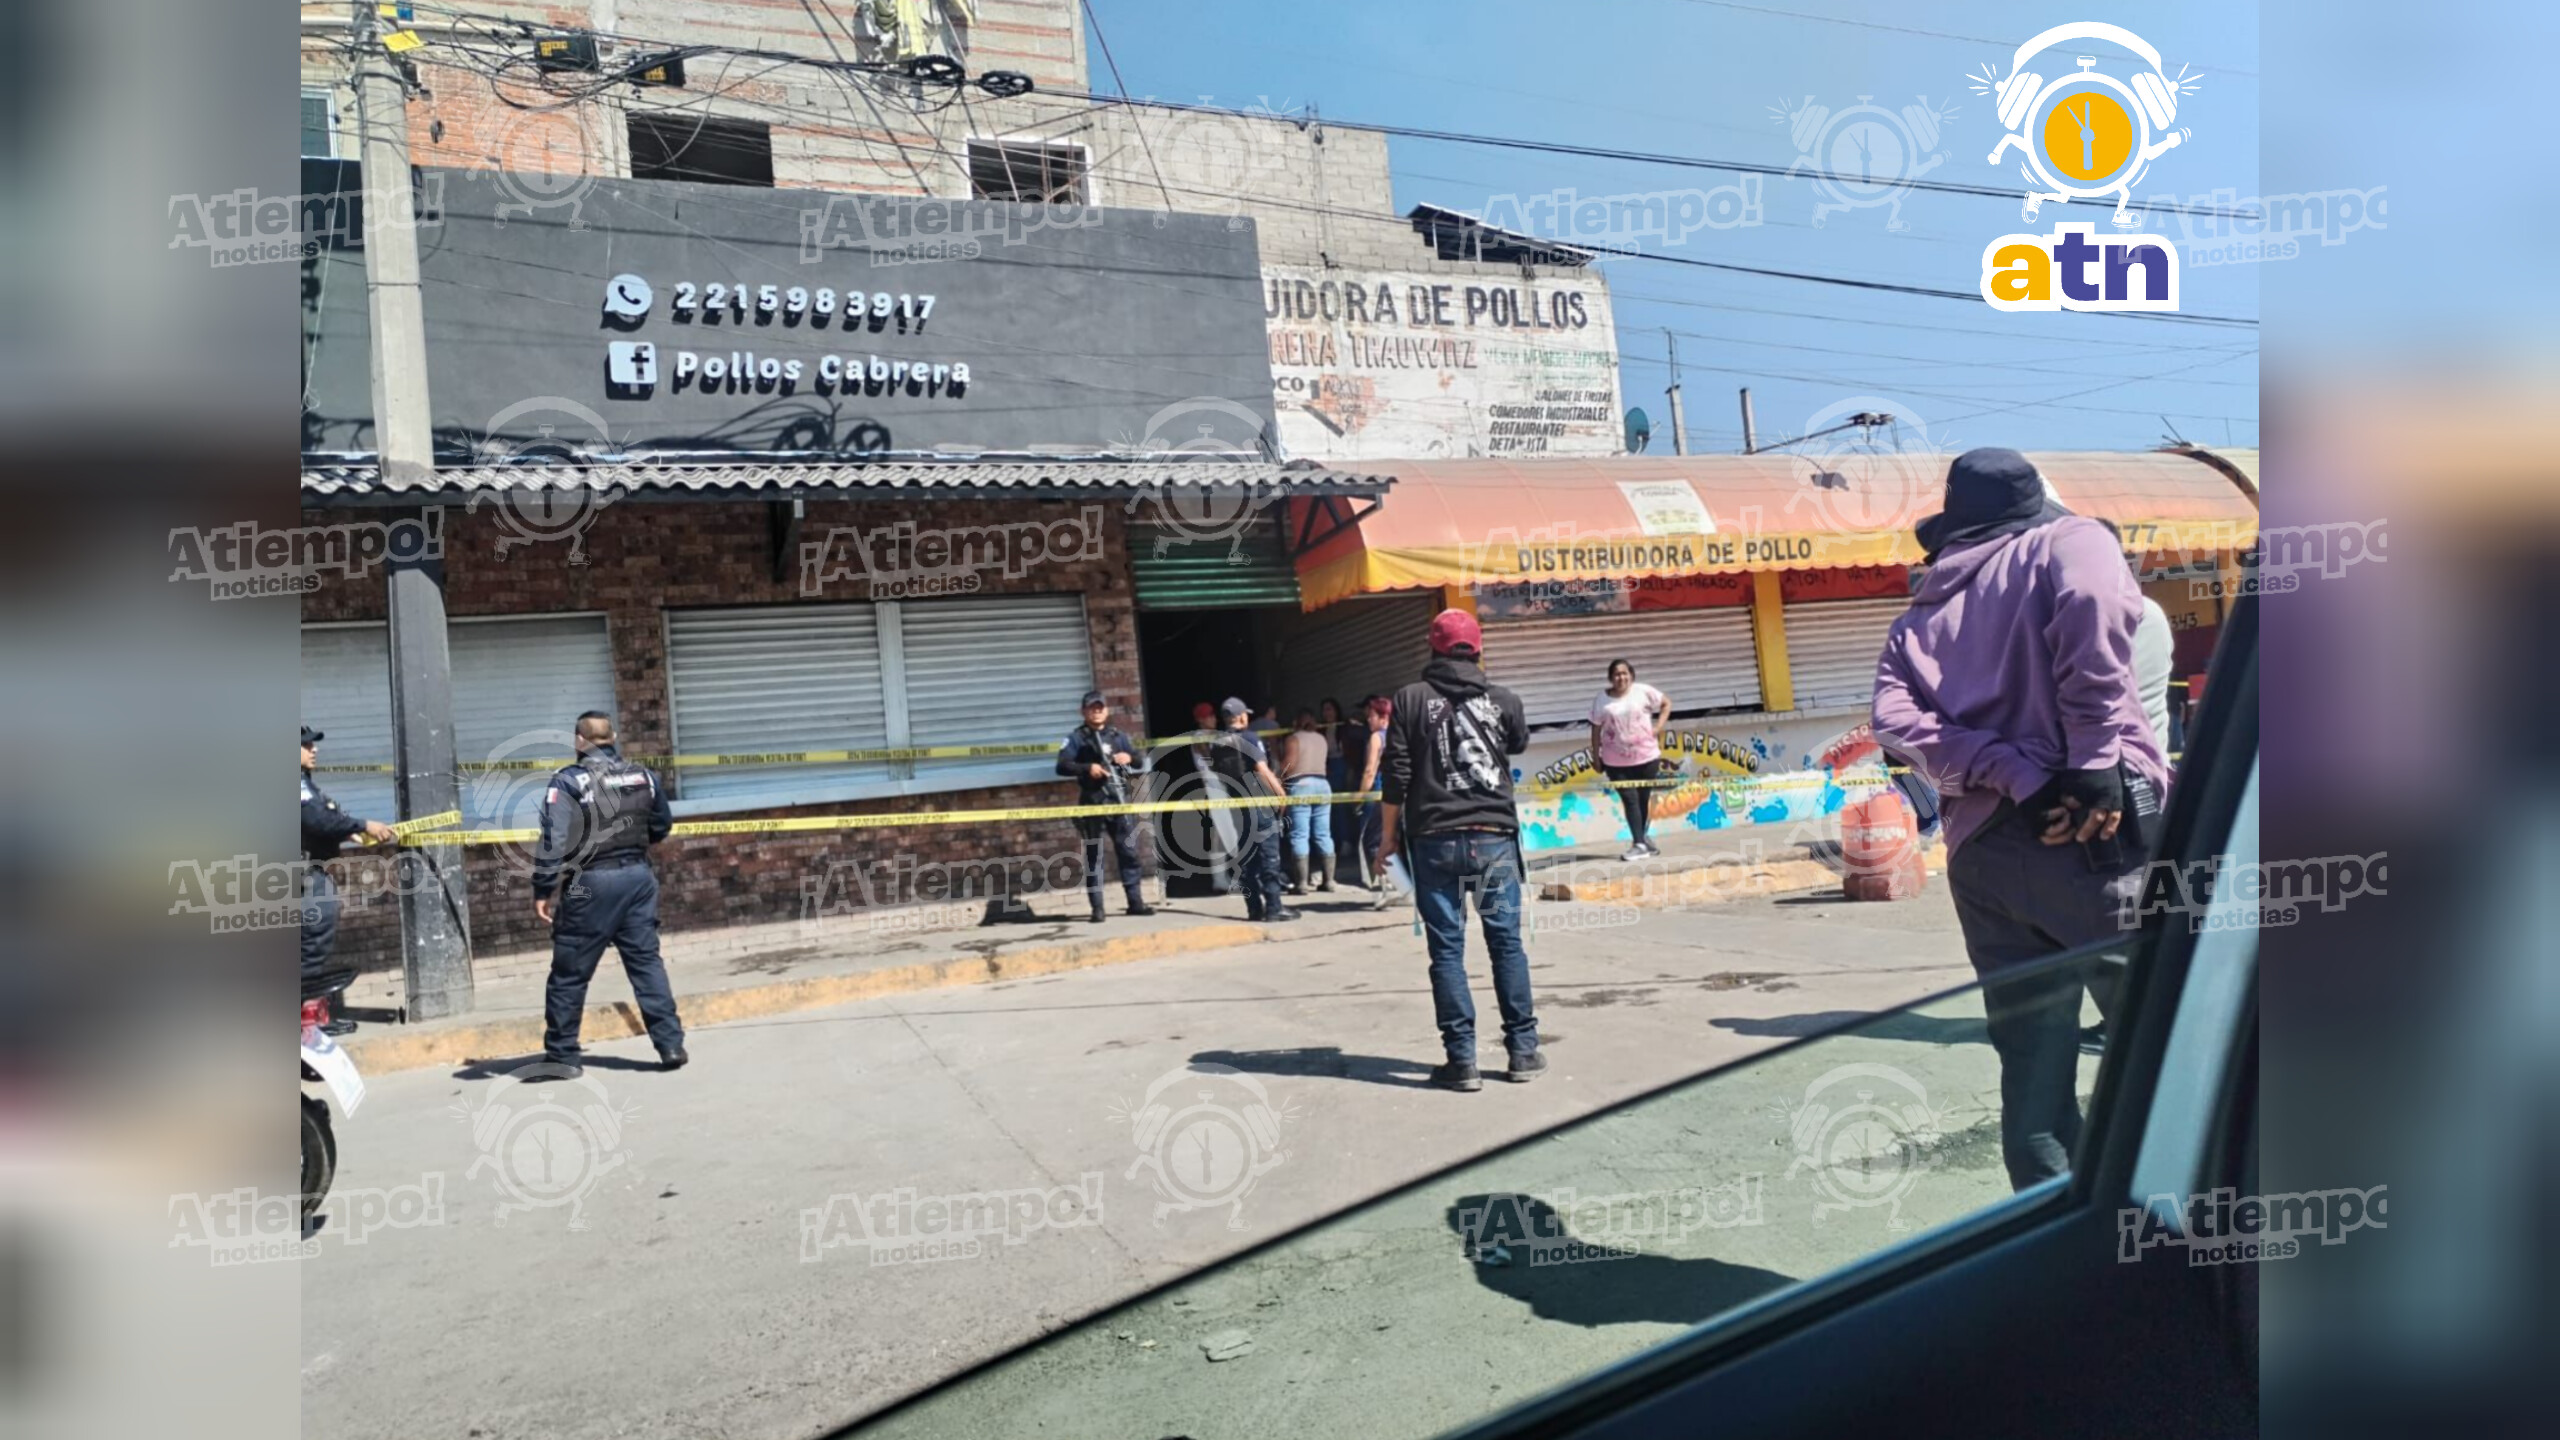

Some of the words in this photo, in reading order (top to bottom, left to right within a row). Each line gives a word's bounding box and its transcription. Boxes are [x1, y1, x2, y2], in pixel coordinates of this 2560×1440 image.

[674, 282, 936, 319] 2215983917
[1410, 285, 1456, 327] DE
[1465, 286, 1588, 330] POLLOS
[676, 351, 804, 379] Pollos
[819, 353, 970, 383] Cabrera
[1488, 420, 1567, 437] RESTAURANTES
[1489, 404, 1545, 420] COMEDORES
[1517, 543, 1695, 573] DISTRIBUIDORA
[1707, 542, 1735, 566] DE
[1745, 537, 1813, 563] POLLO
